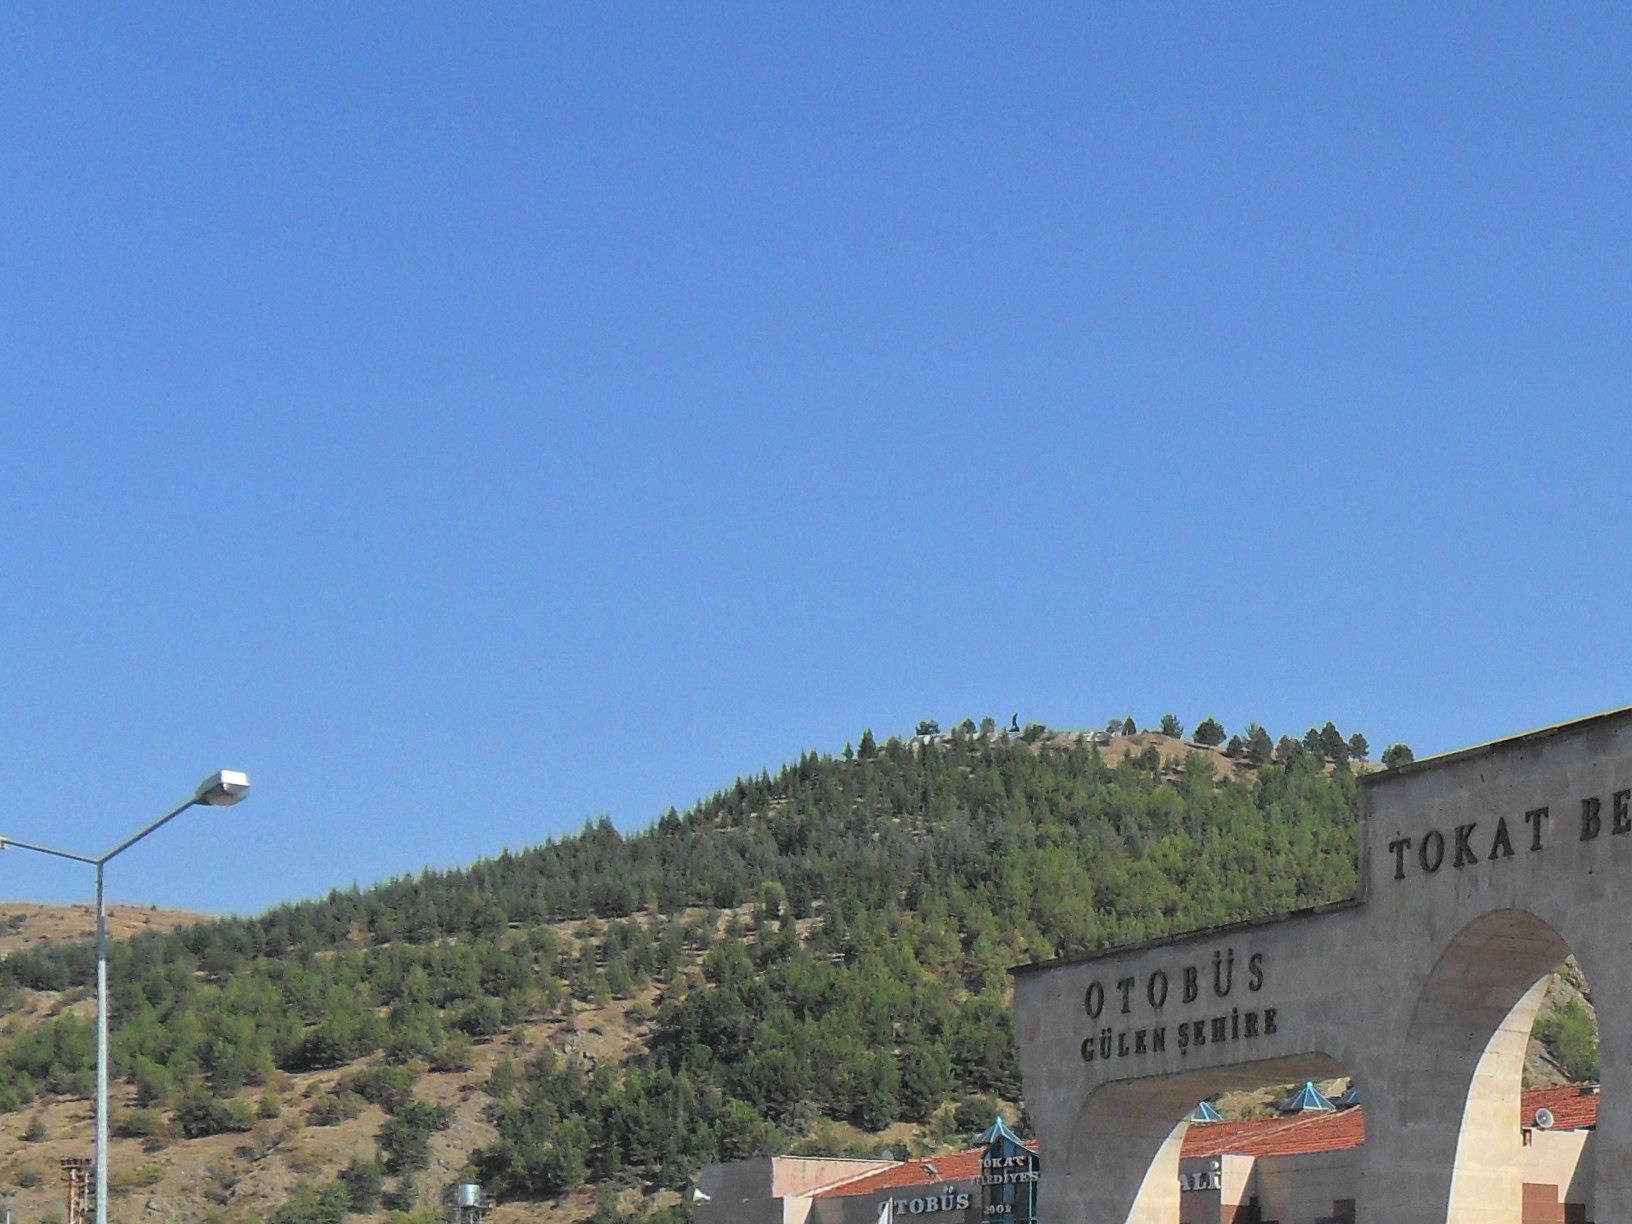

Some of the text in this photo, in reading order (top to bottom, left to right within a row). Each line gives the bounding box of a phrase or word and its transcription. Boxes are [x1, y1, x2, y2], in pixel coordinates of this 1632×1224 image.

[1388, 806, 1549, 880] TOKAT
[1084, 947, 1264, 1019] OTOBÜS
[1081, 1006, 1278, 1062] GÜLEN ŞEHİRE
